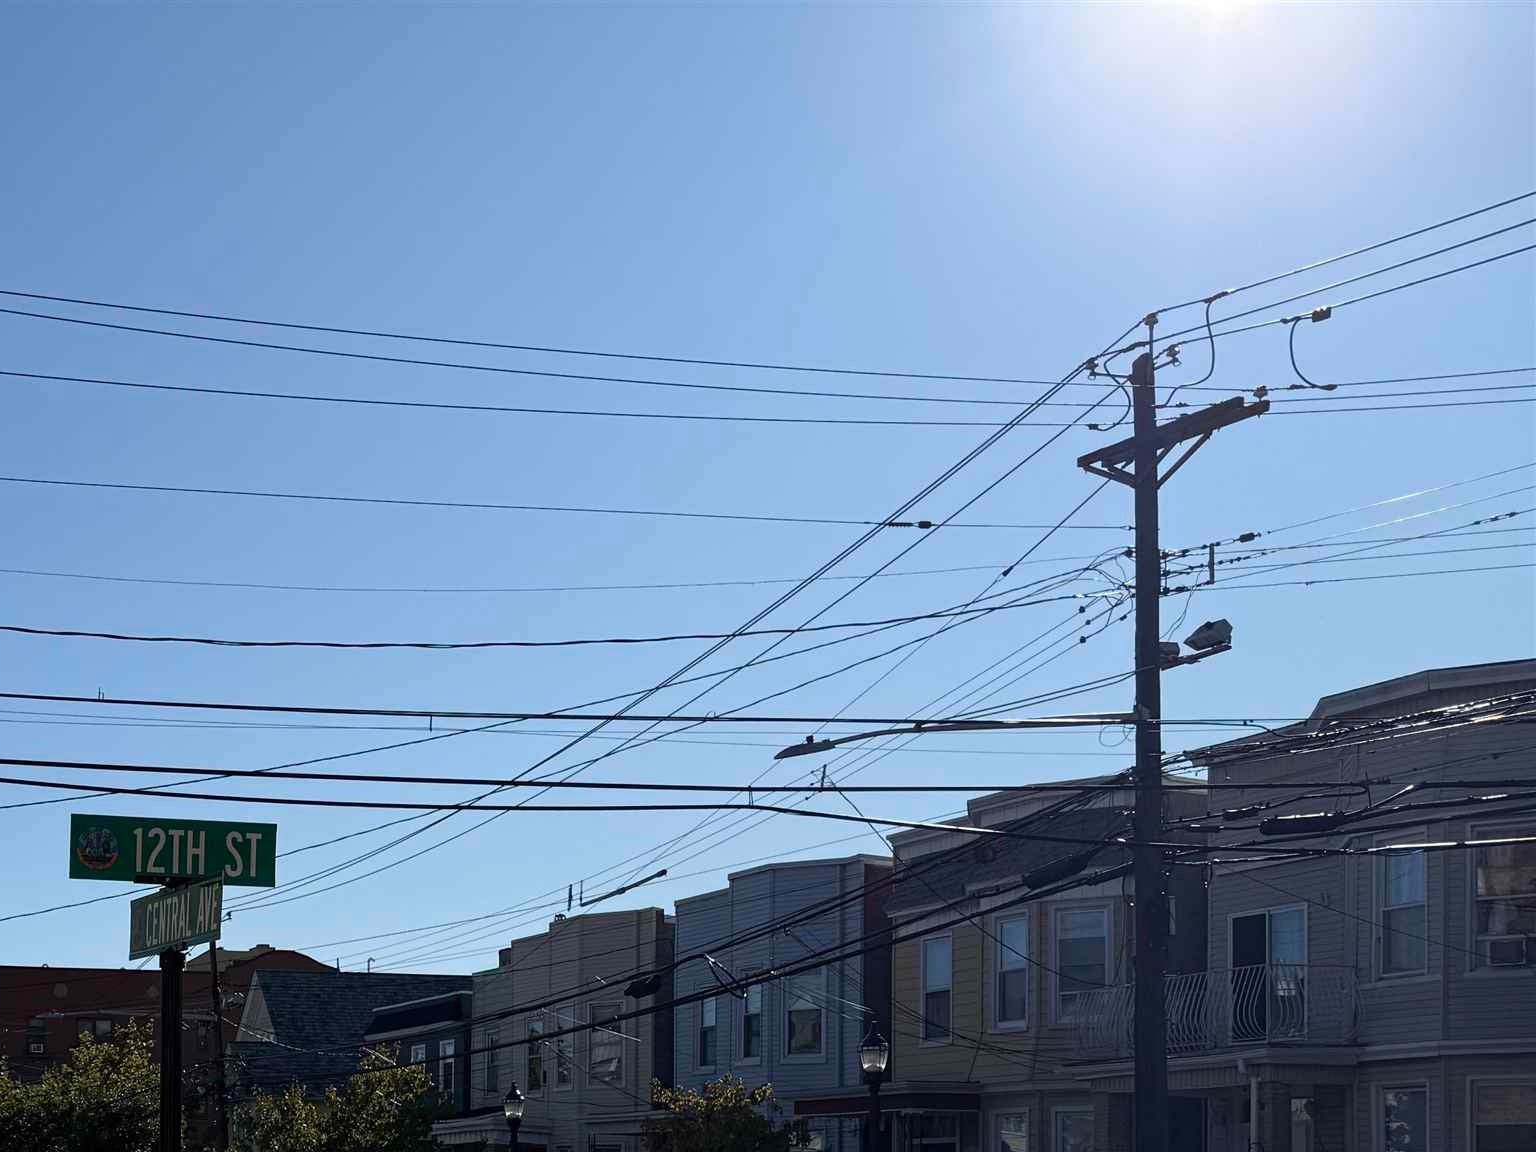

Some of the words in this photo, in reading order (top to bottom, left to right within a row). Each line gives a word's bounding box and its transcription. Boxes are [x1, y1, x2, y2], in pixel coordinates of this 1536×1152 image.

[133, 827, 206, 875] 12TH
[224, 831, 262, 878] ST
[145, 886, 191, 947] CENTRAL
[196, 883, 219, 935] AVE
